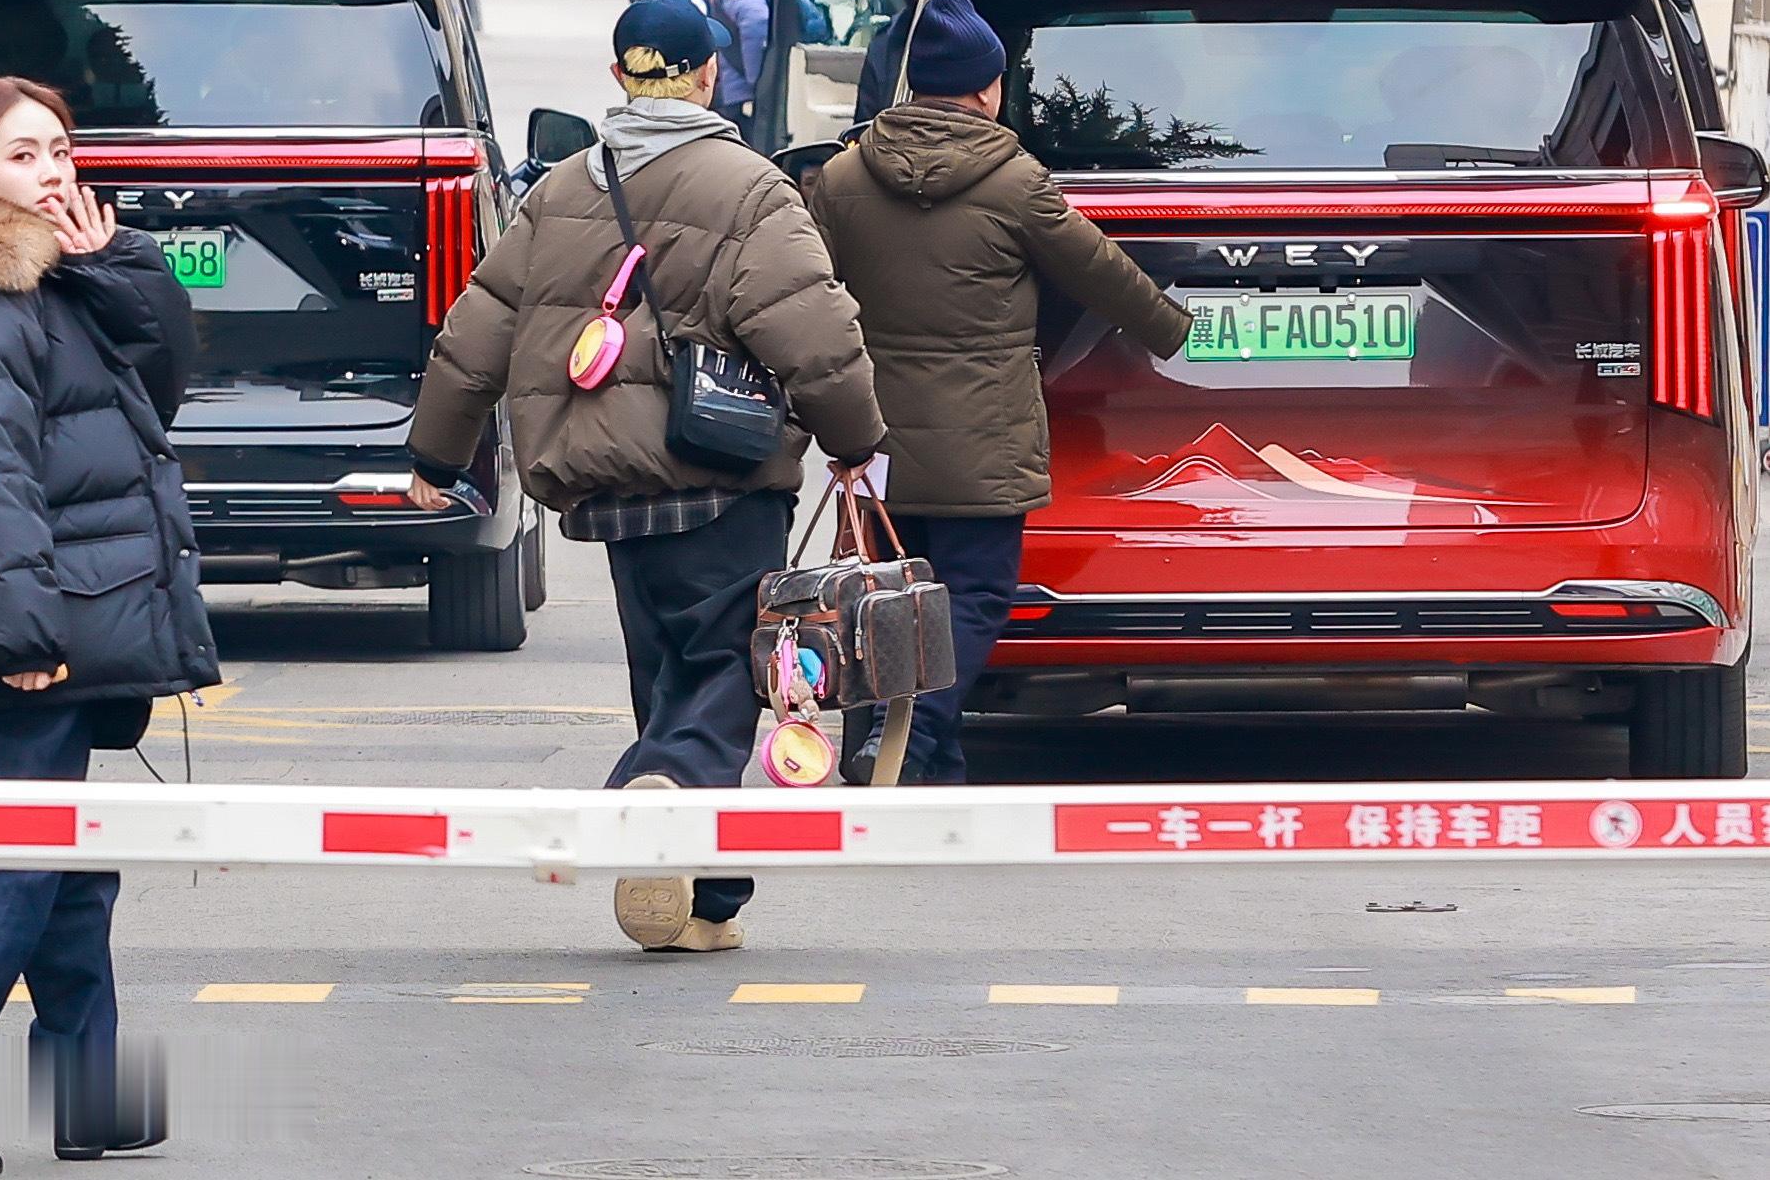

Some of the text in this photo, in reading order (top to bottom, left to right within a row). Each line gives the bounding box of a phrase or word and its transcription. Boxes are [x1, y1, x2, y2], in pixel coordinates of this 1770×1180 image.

[115, 190, 195, 210] EY
[159, 240, 218, 277] 558
[1216, 244, 1380, 267] WEY
[1105, 802, 1770, 850] 一车一杆 保持车距 人员
